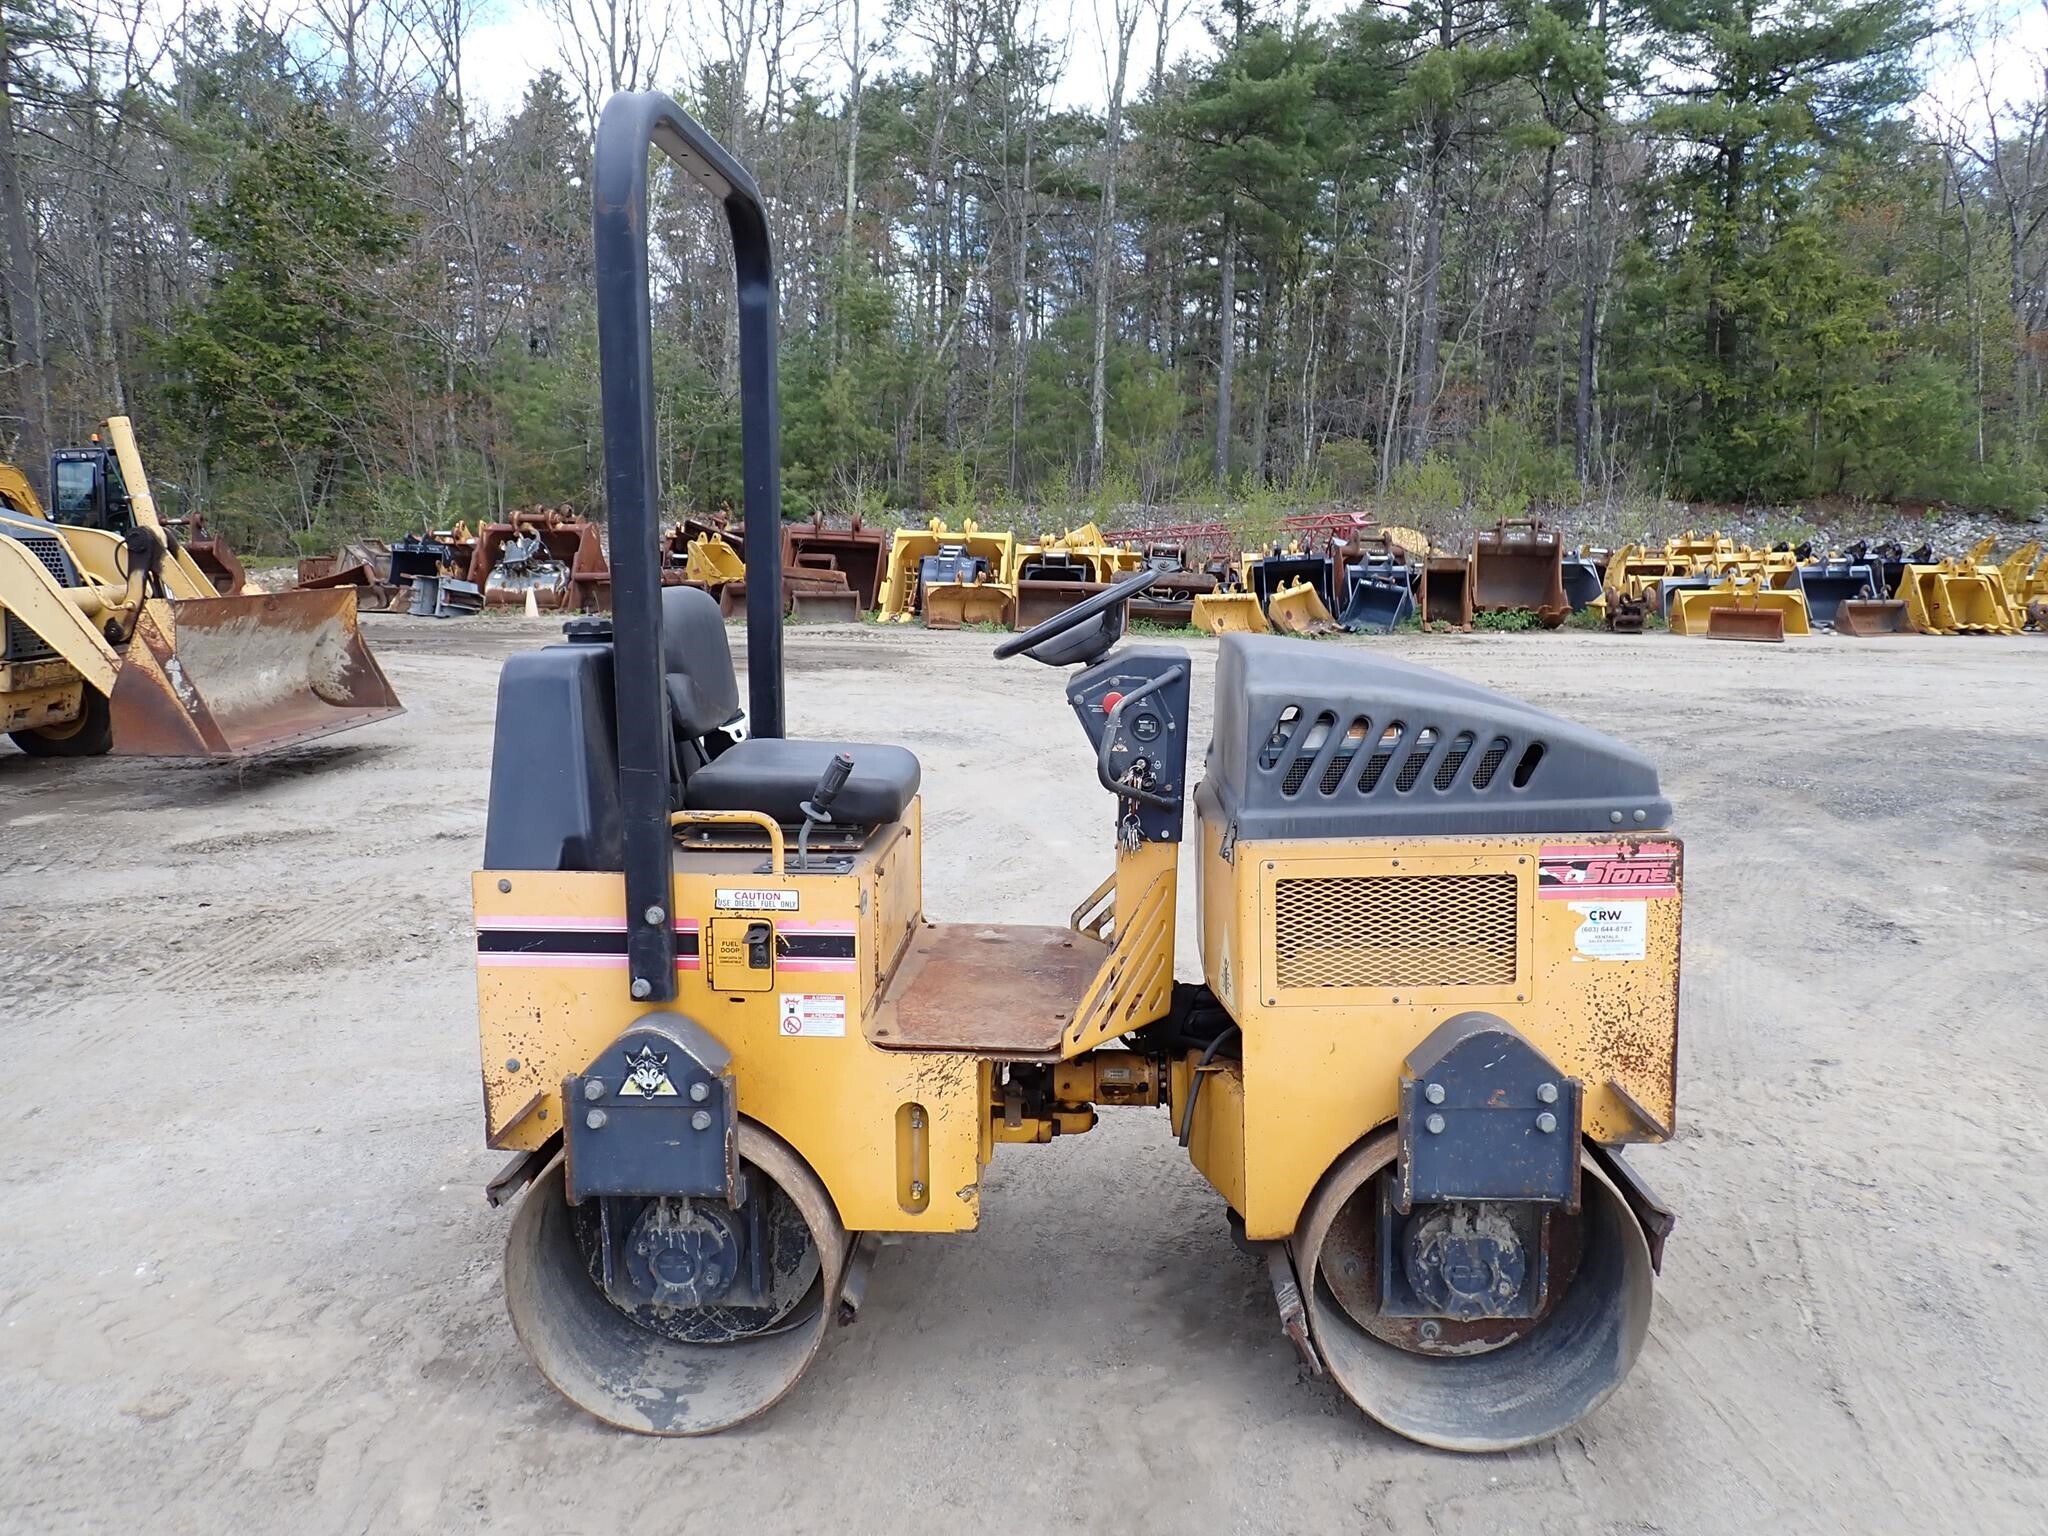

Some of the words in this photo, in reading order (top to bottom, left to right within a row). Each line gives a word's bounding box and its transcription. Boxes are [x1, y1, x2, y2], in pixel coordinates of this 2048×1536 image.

[1584, 860, 1670, 884] Stone
[734, 891, 781, 900] CAUTION
[717, 899, 731, 907] USE
[760, 900, 776, 908] FUEL
[1589, 910, 1622, 921] CRW
